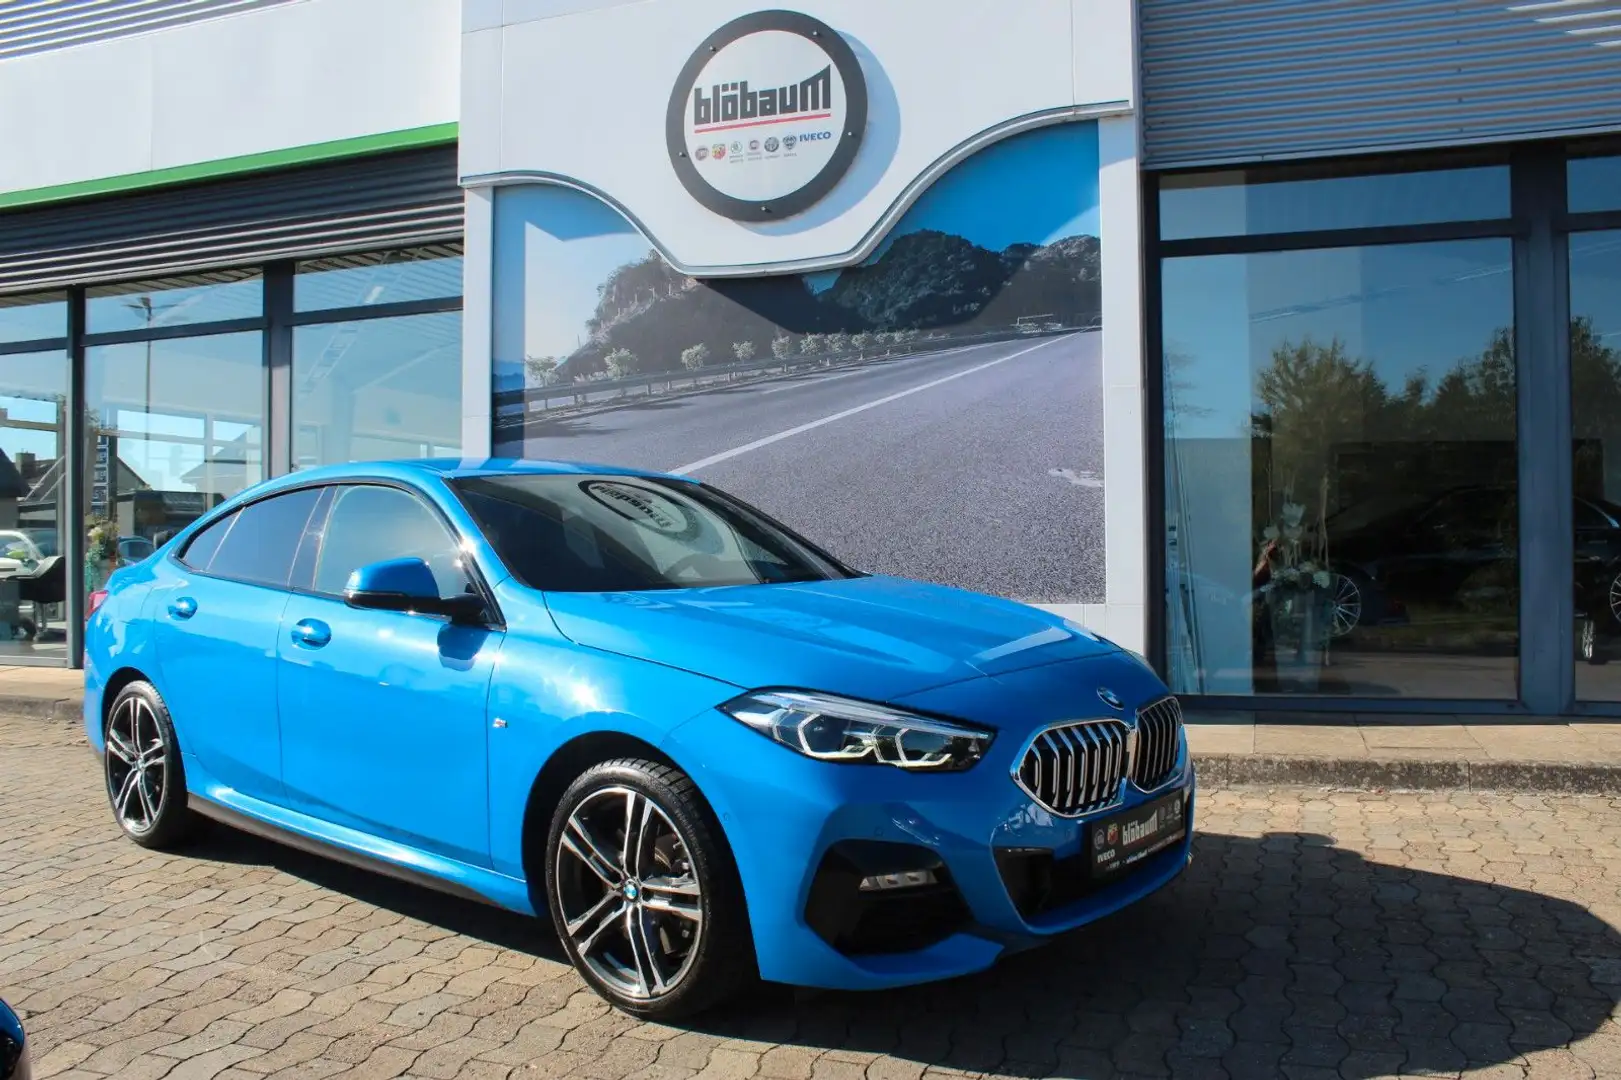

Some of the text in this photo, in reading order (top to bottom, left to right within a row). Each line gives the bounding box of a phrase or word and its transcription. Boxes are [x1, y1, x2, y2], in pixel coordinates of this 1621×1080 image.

[694, 64, 831, 126] blöbaum
[799, 131, 832, 142] IVECO
[1097, 848, 1116, 863] IVECO
